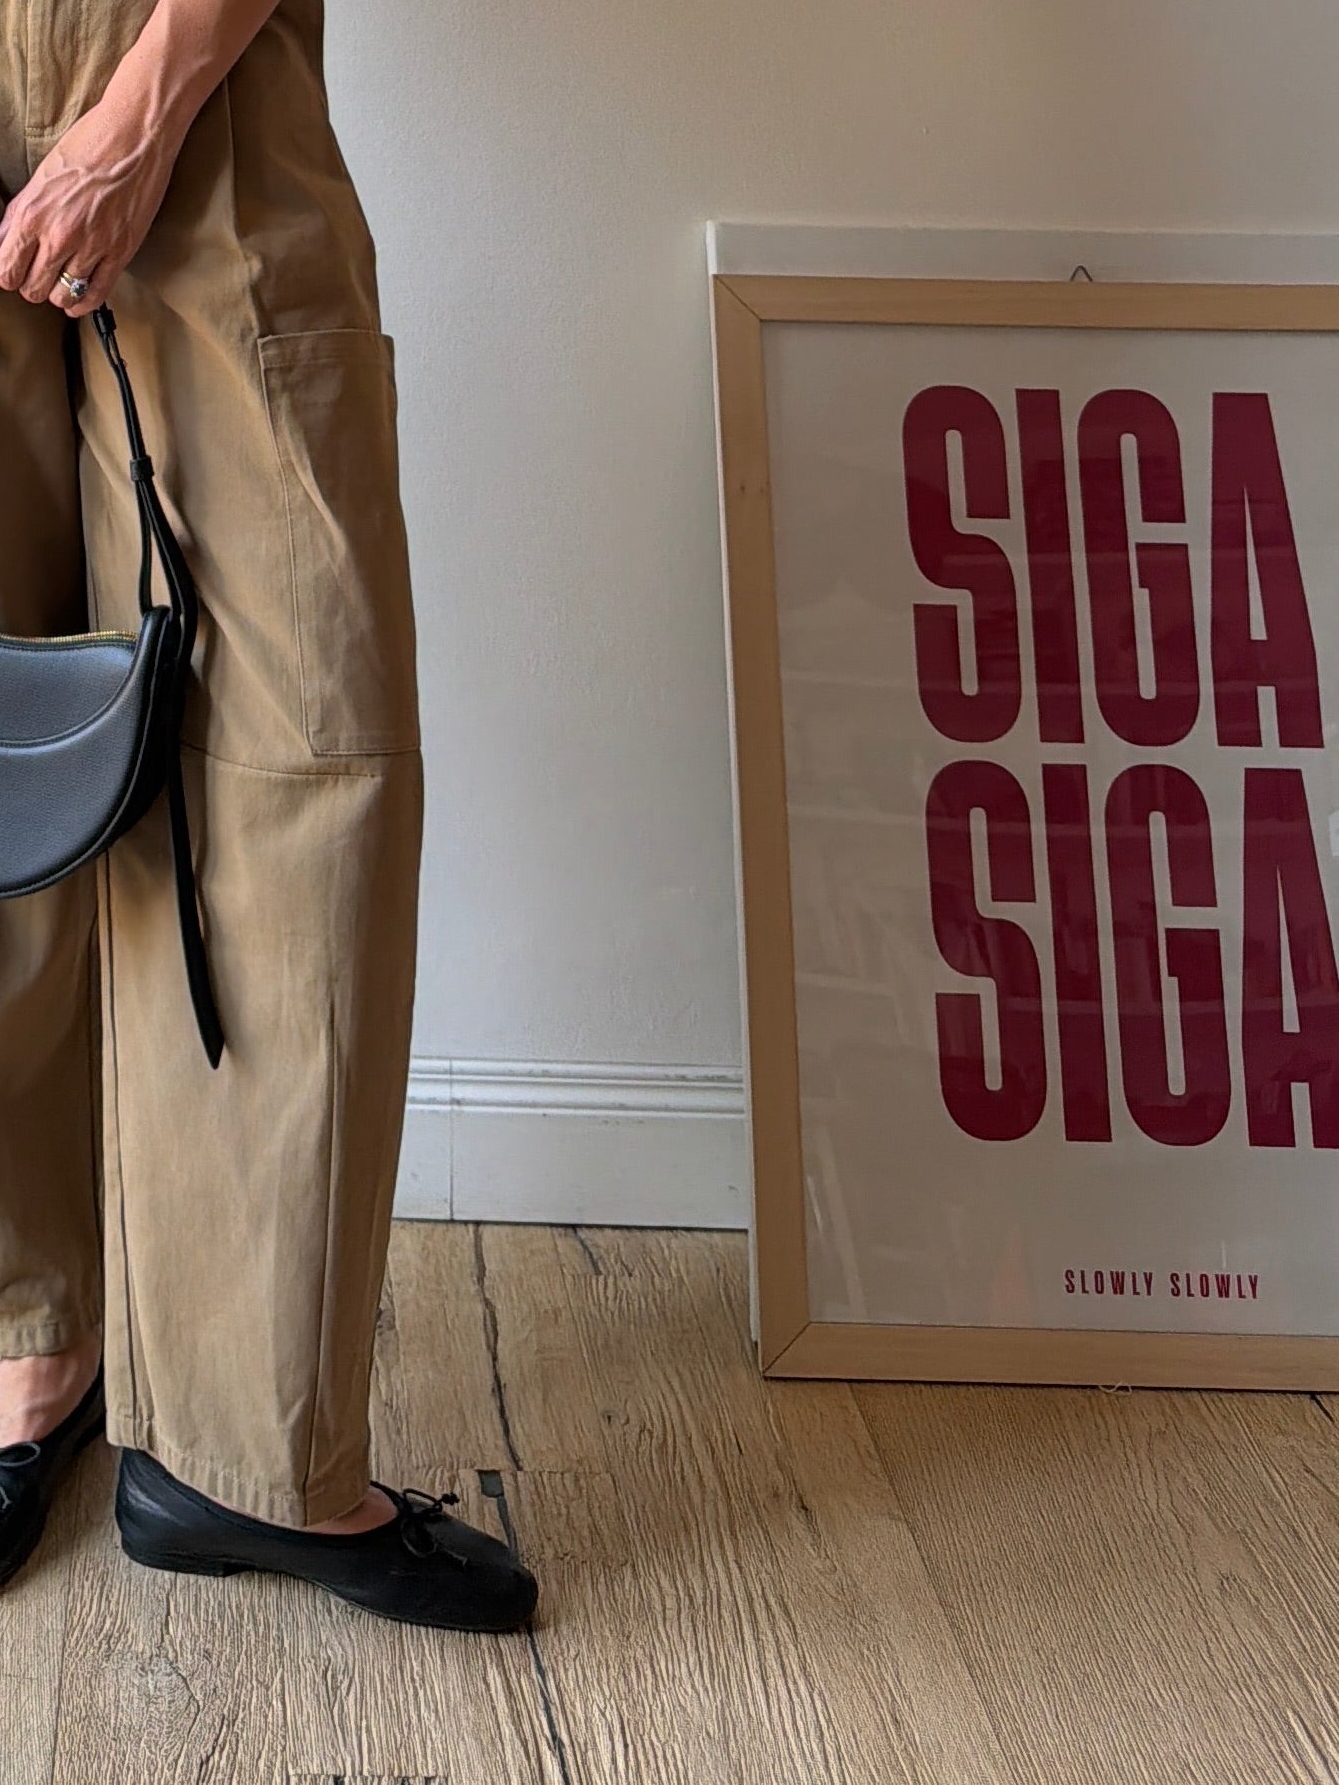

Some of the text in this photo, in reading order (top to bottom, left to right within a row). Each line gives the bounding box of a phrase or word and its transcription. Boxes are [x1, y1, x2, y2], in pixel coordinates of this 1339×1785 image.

[902, 385, 1325, 748] SIGA
[925, 759, 1339, 1149] SIGA
[1064, 1269, 1259, 1300] SLOWLY SLOWLY
